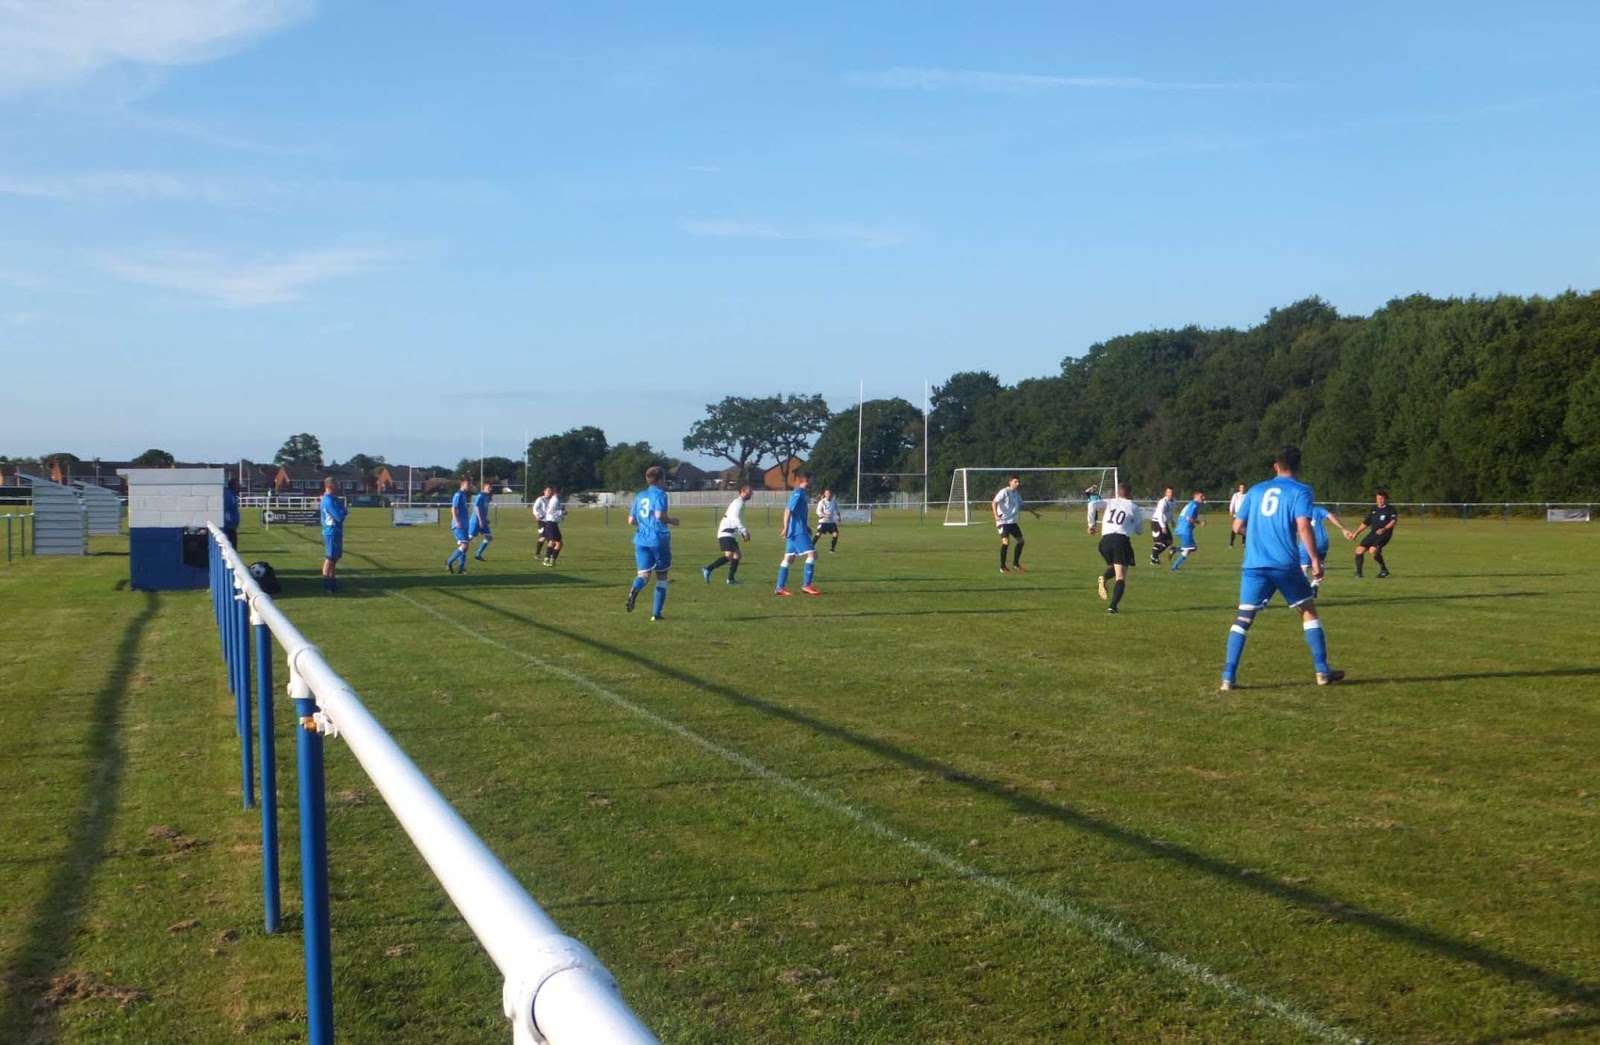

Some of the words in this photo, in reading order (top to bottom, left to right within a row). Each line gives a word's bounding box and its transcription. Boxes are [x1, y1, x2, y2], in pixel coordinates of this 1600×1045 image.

[640, 497, 650, 518] 3
[1261, 487, 1282, 517] 6
[1106, 508, 1126, 525] 10
